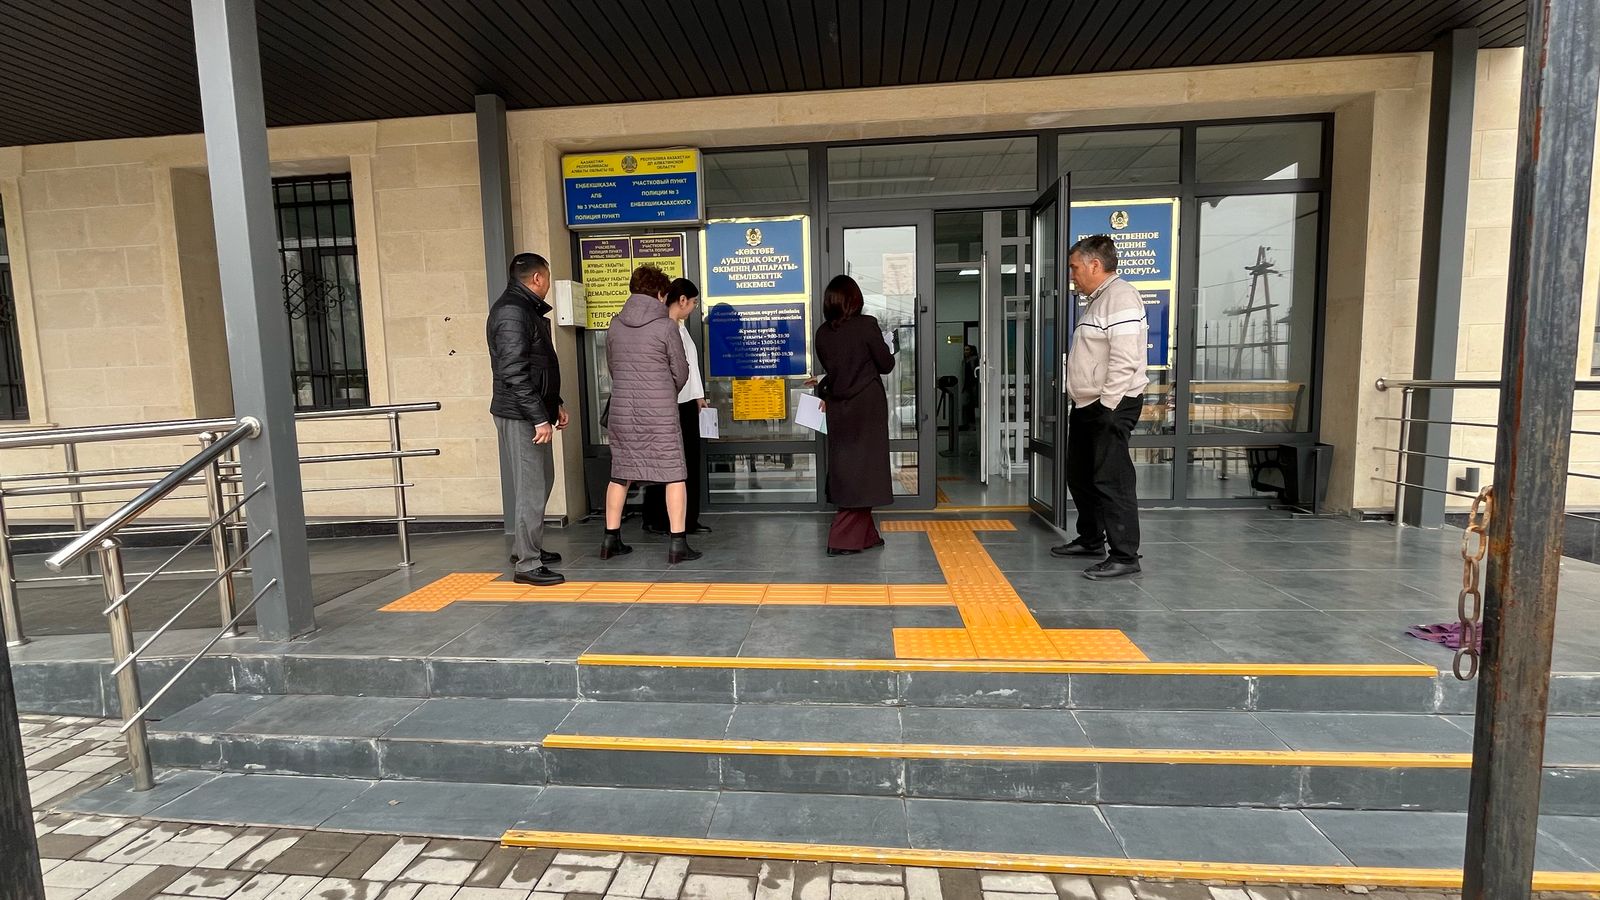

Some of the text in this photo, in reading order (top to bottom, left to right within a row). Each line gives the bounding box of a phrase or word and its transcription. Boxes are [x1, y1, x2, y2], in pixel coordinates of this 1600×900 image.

[1124, 249, 1156, 258] АКИМА
[720, 255, 790, 266] АУЫЛДЫҚ ОКРУГІ
[712, 265, 750, 274] ӘКІМІНІҢ
[1124, 267, 1161, 276] ОКРУГА»
[728, 272, 783, 281] МЕМЛЕКЕТТІК
[736, 280, 776, 289] МЕКЕМЕСІ
